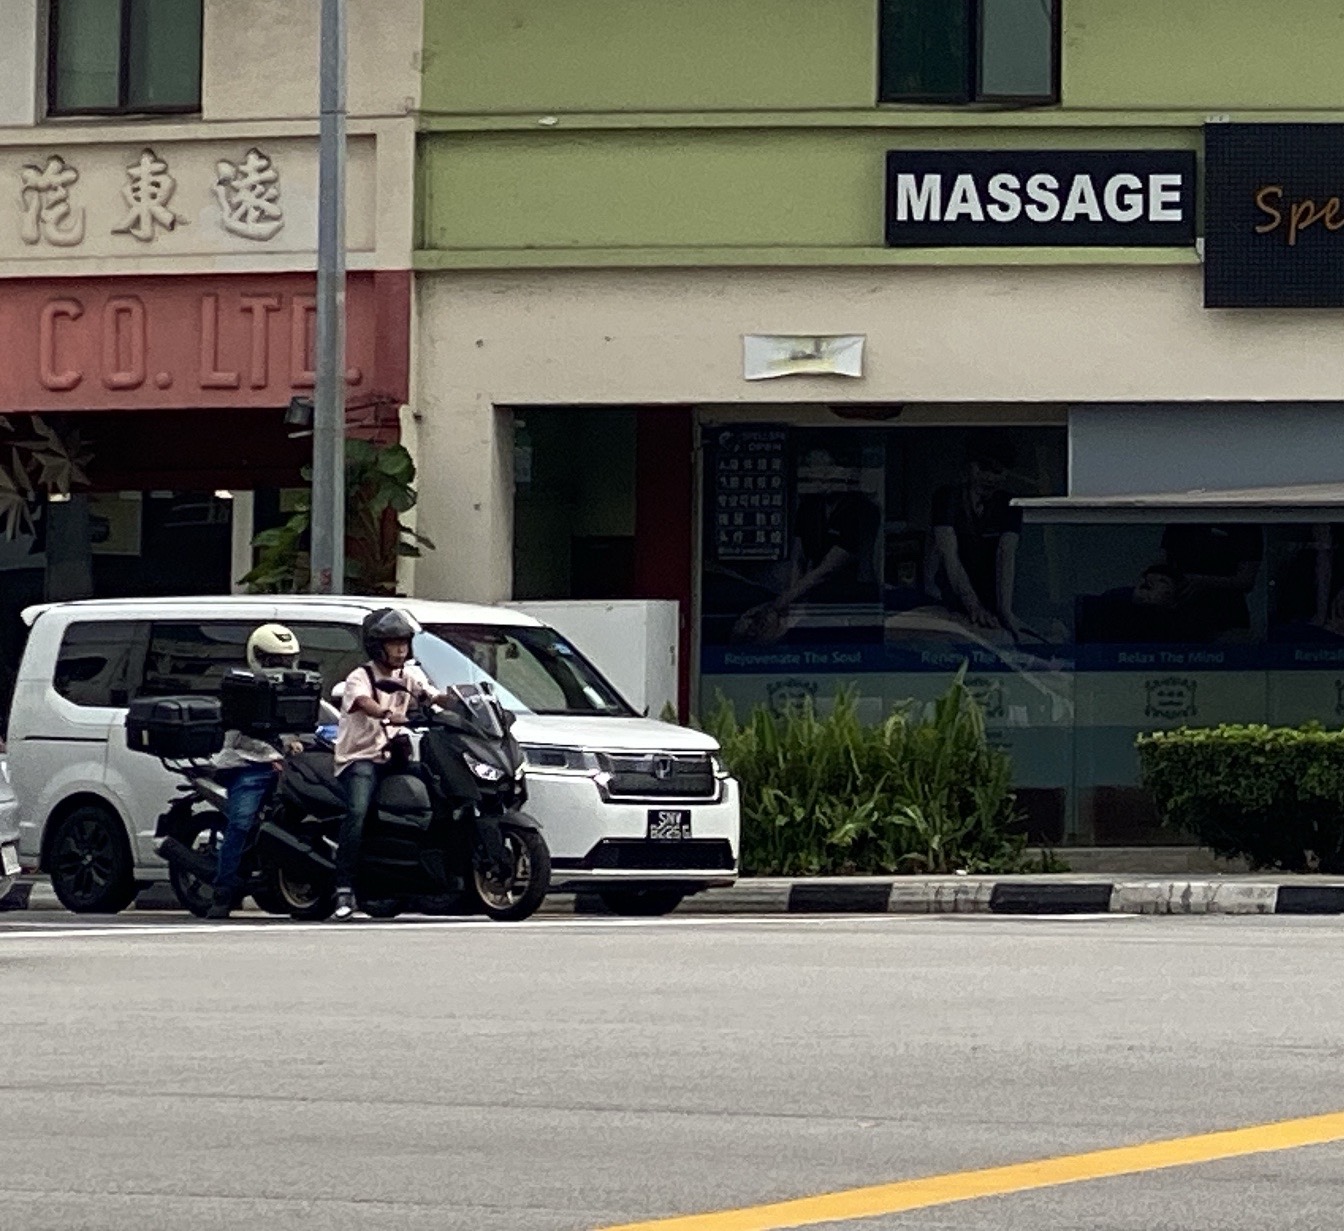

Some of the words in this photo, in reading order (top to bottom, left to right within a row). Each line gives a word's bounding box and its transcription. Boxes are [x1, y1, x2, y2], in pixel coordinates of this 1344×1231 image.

[894, 172, 1184, 225] MASSAGE
[39, 294, 172, 392] CO.
[724, 651, 800, 667] Rejuvenate
[805, 650, 831, 664] The
[833, 650, 863, 664] Soul
[1118, 650, 1156, 664] Relax
[1160, 650, 1185, 664] The
[1187, 650, 1225, 664] Mind
